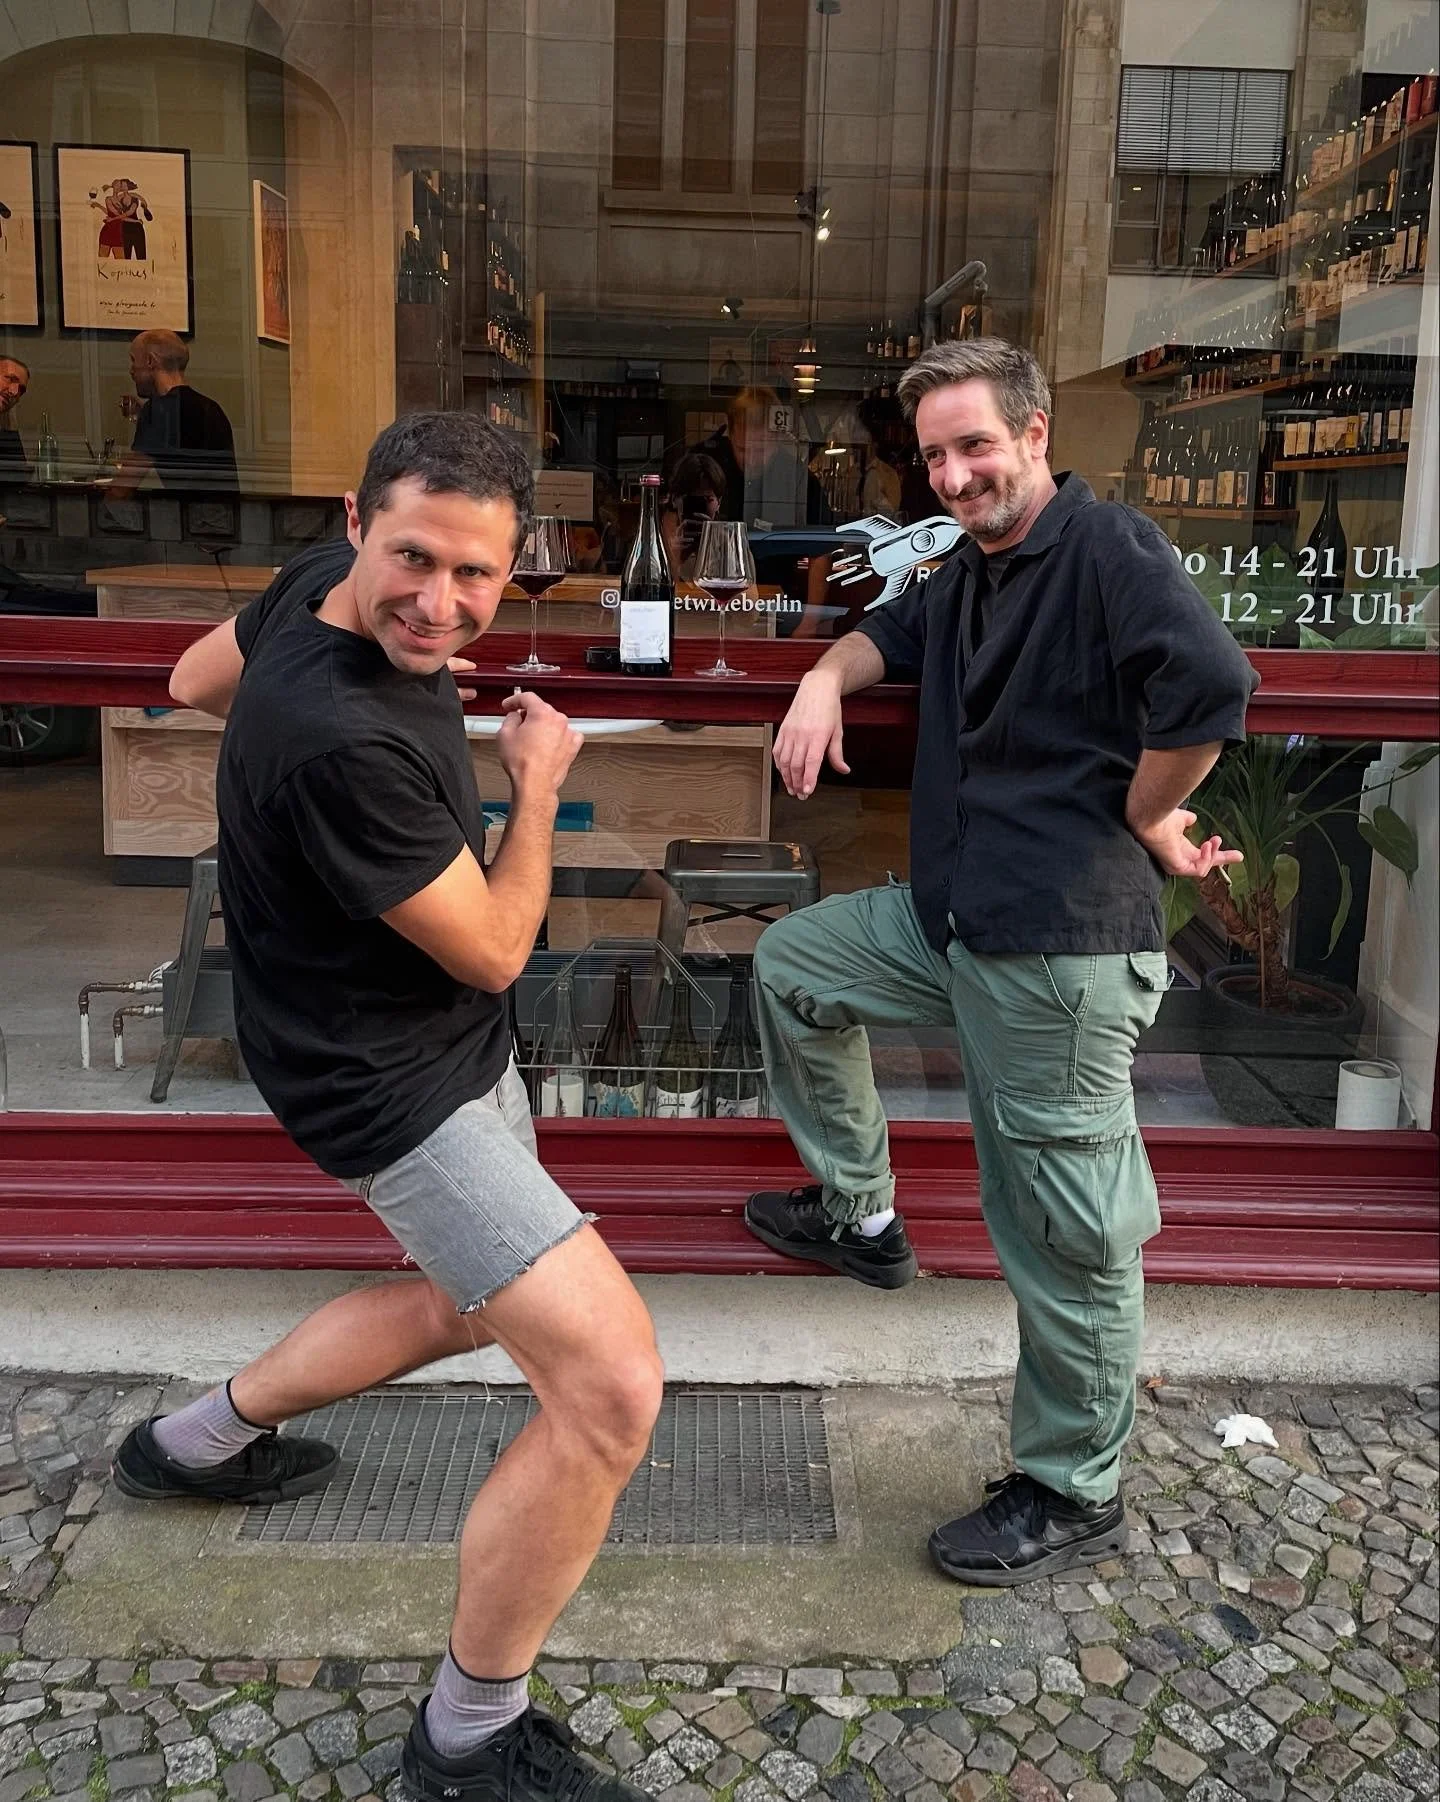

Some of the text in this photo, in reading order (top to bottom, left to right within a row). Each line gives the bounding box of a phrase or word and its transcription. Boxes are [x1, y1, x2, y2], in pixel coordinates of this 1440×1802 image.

[1219, 545, 1261, 576] 14
[1296, 546, 1337, 578] 21
[1353, 545, 1421, 579] Uhr
[1221, 592, 1258, 622] 12
[1294, 593, 1335, 624] 21
[1350, 592, 1419, 625] Uhr
